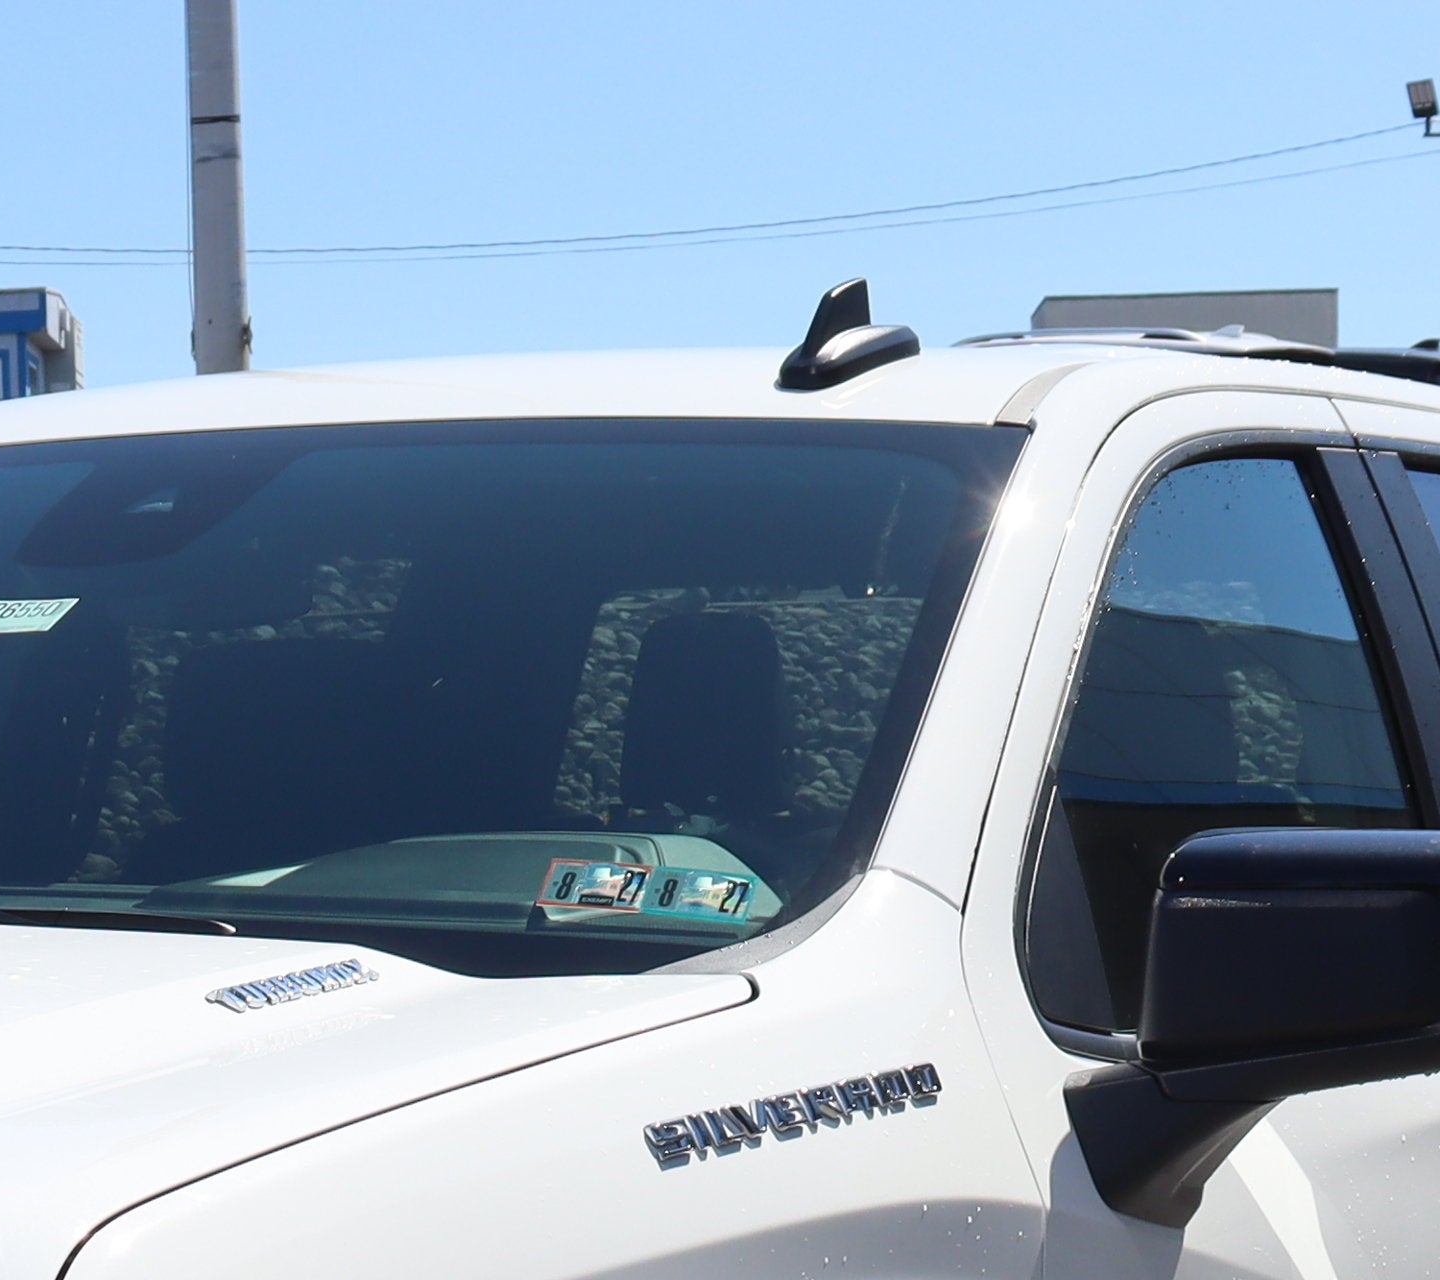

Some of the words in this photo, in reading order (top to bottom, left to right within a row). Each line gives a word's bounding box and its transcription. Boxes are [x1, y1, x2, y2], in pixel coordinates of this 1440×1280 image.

[554, 870, 577, 900] 8
[616, 868, 648, 906] 27
[657, 877, 679, 907] 8
[717, 879, 750, 915] 27
[643, 1062, 943, 1162] SILVERADO
